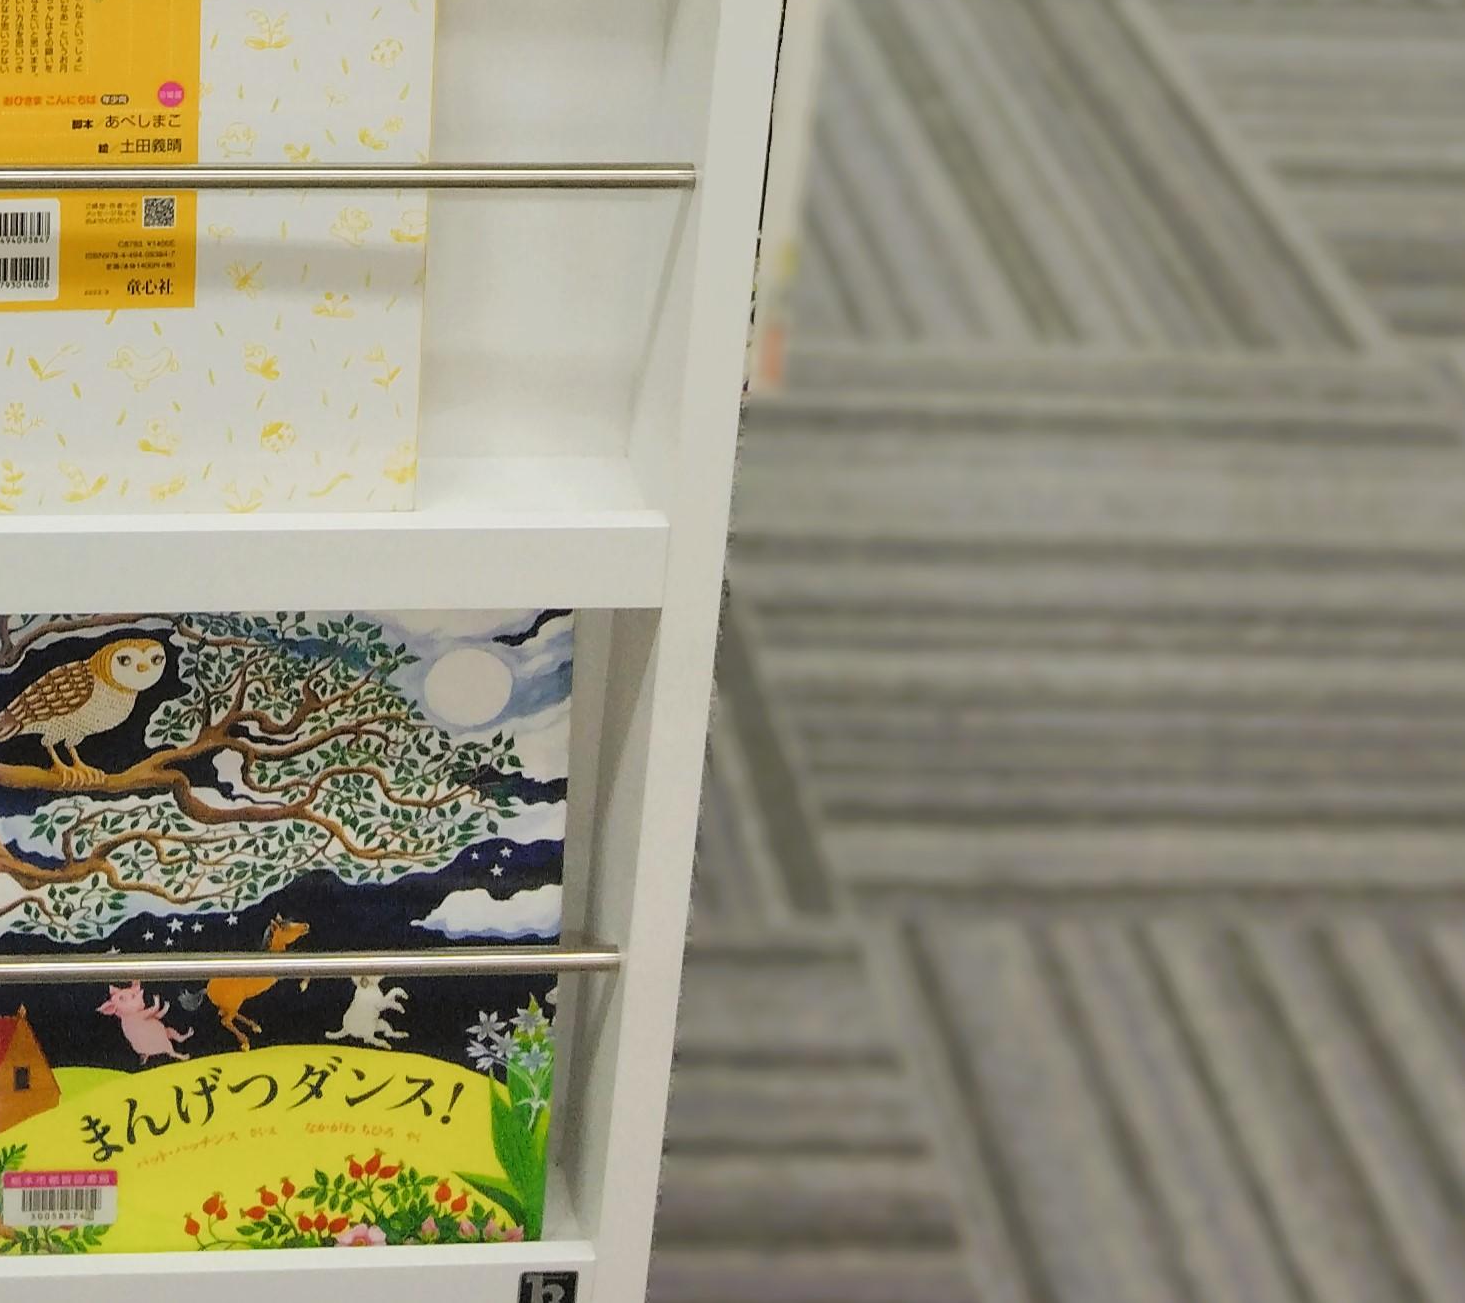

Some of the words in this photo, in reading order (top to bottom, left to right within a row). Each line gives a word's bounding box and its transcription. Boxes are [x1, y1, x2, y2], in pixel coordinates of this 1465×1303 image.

[81, 1056, 466, 1162] まんげつダンス!
